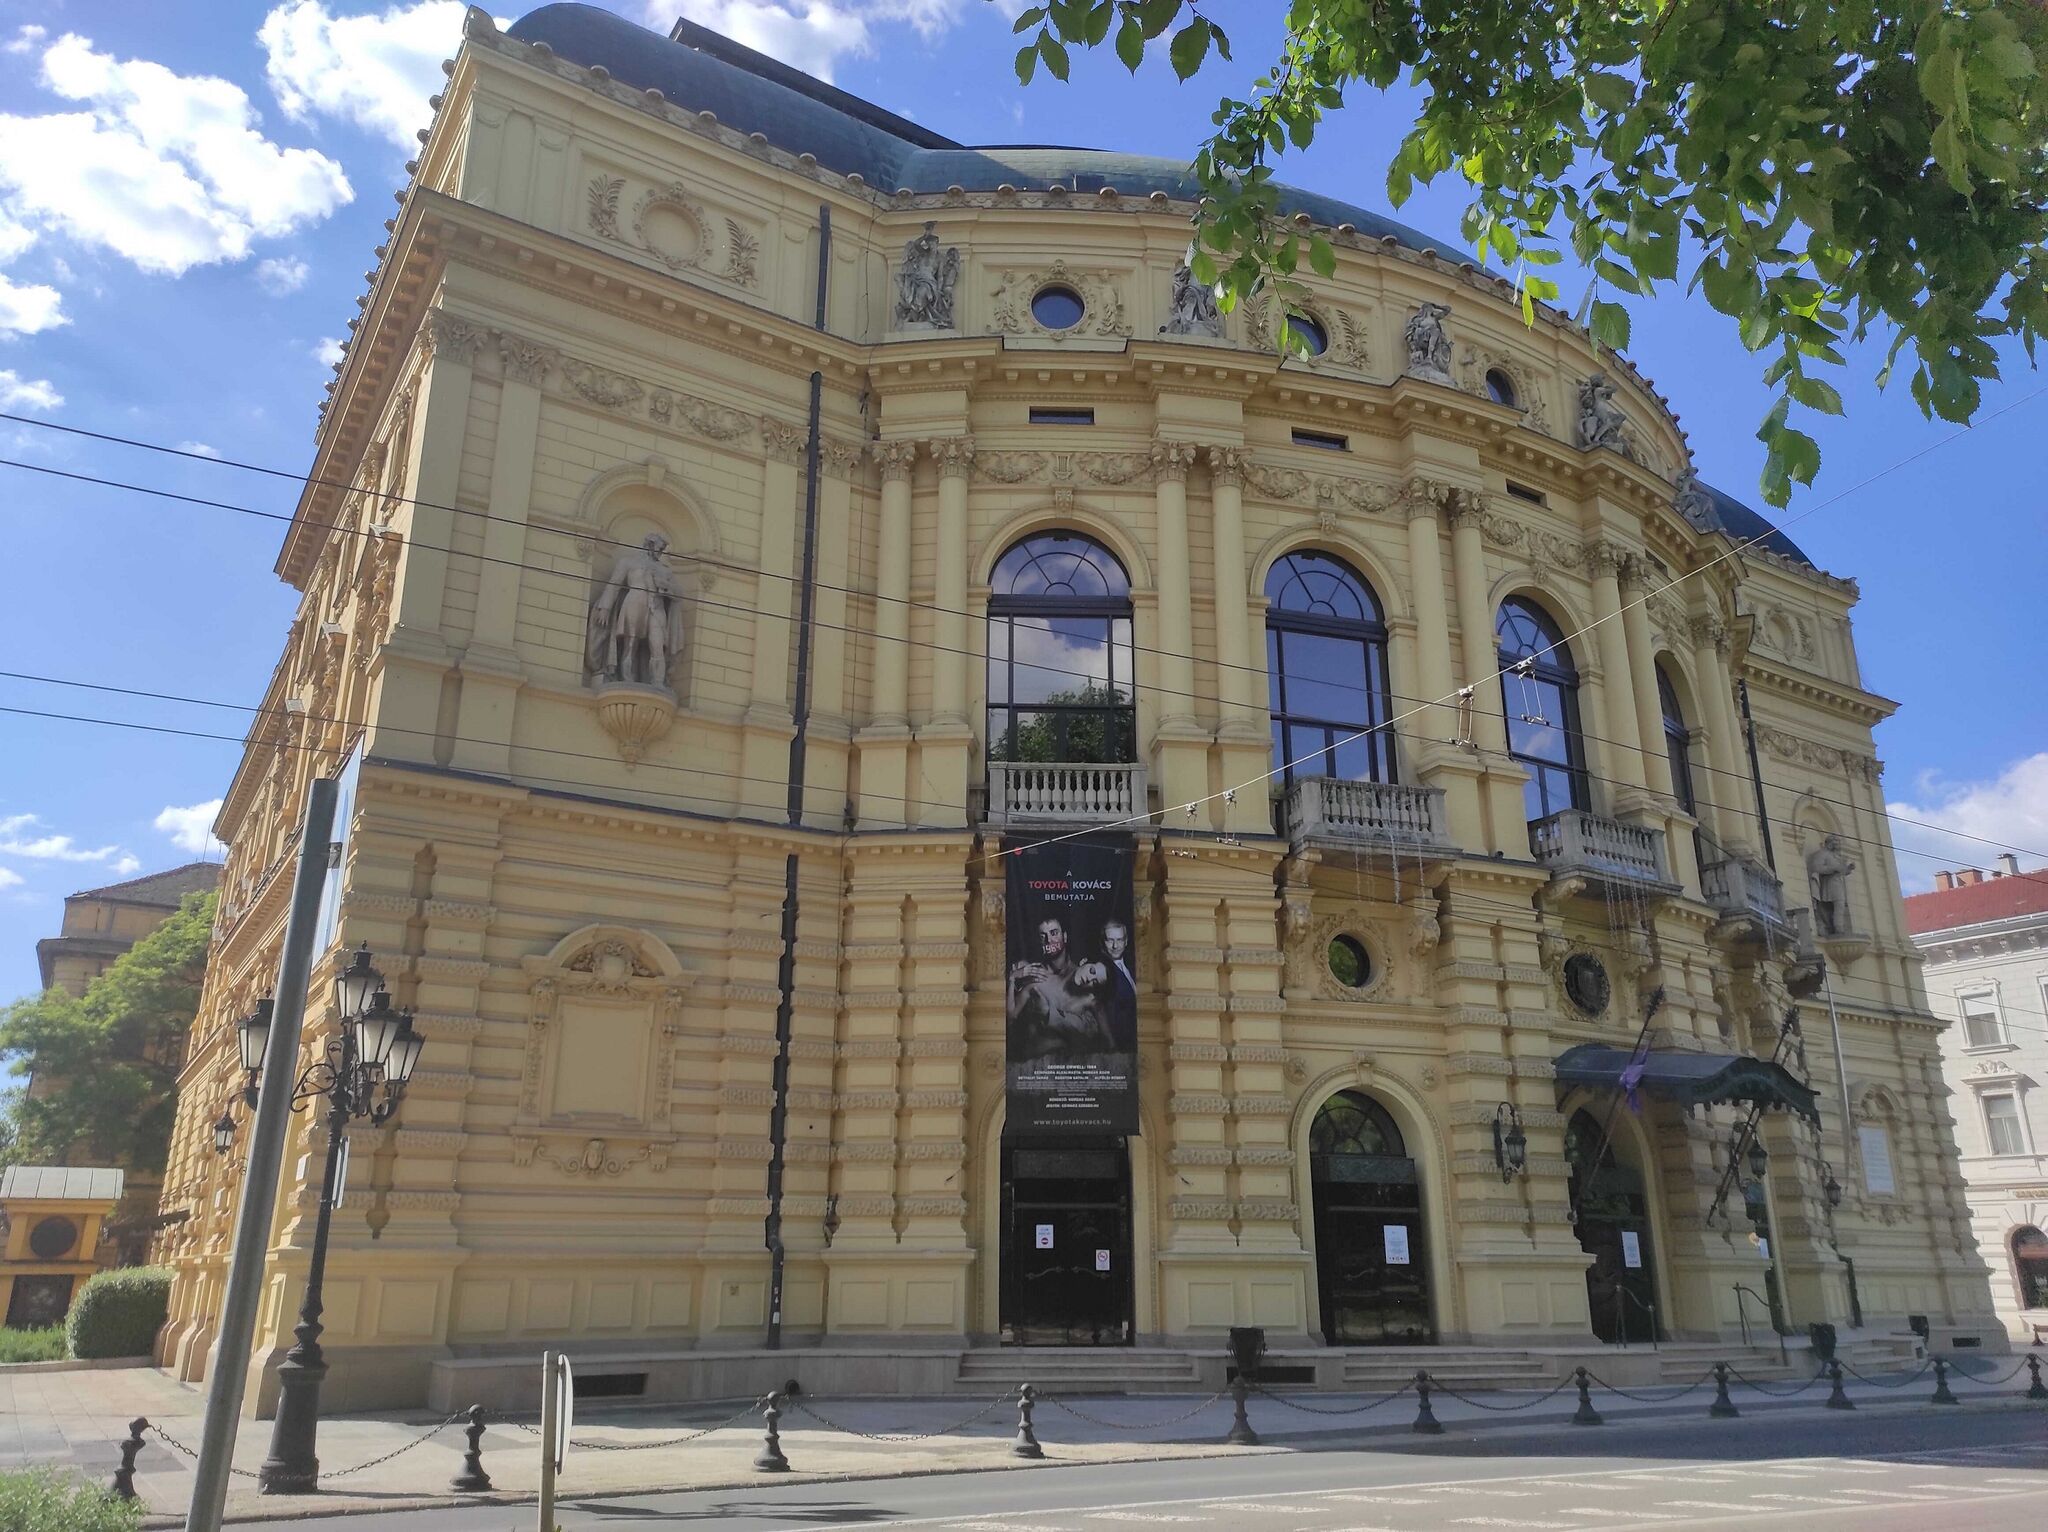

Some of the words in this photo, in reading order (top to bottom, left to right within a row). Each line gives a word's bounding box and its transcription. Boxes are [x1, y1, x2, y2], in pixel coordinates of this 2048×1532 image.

[1028, 881, 1069, 889] TOYOTA
[1072, 879, 1112, 889] KOVÁCS
[1044, 893, 1095, 901] BEMUTATJA
